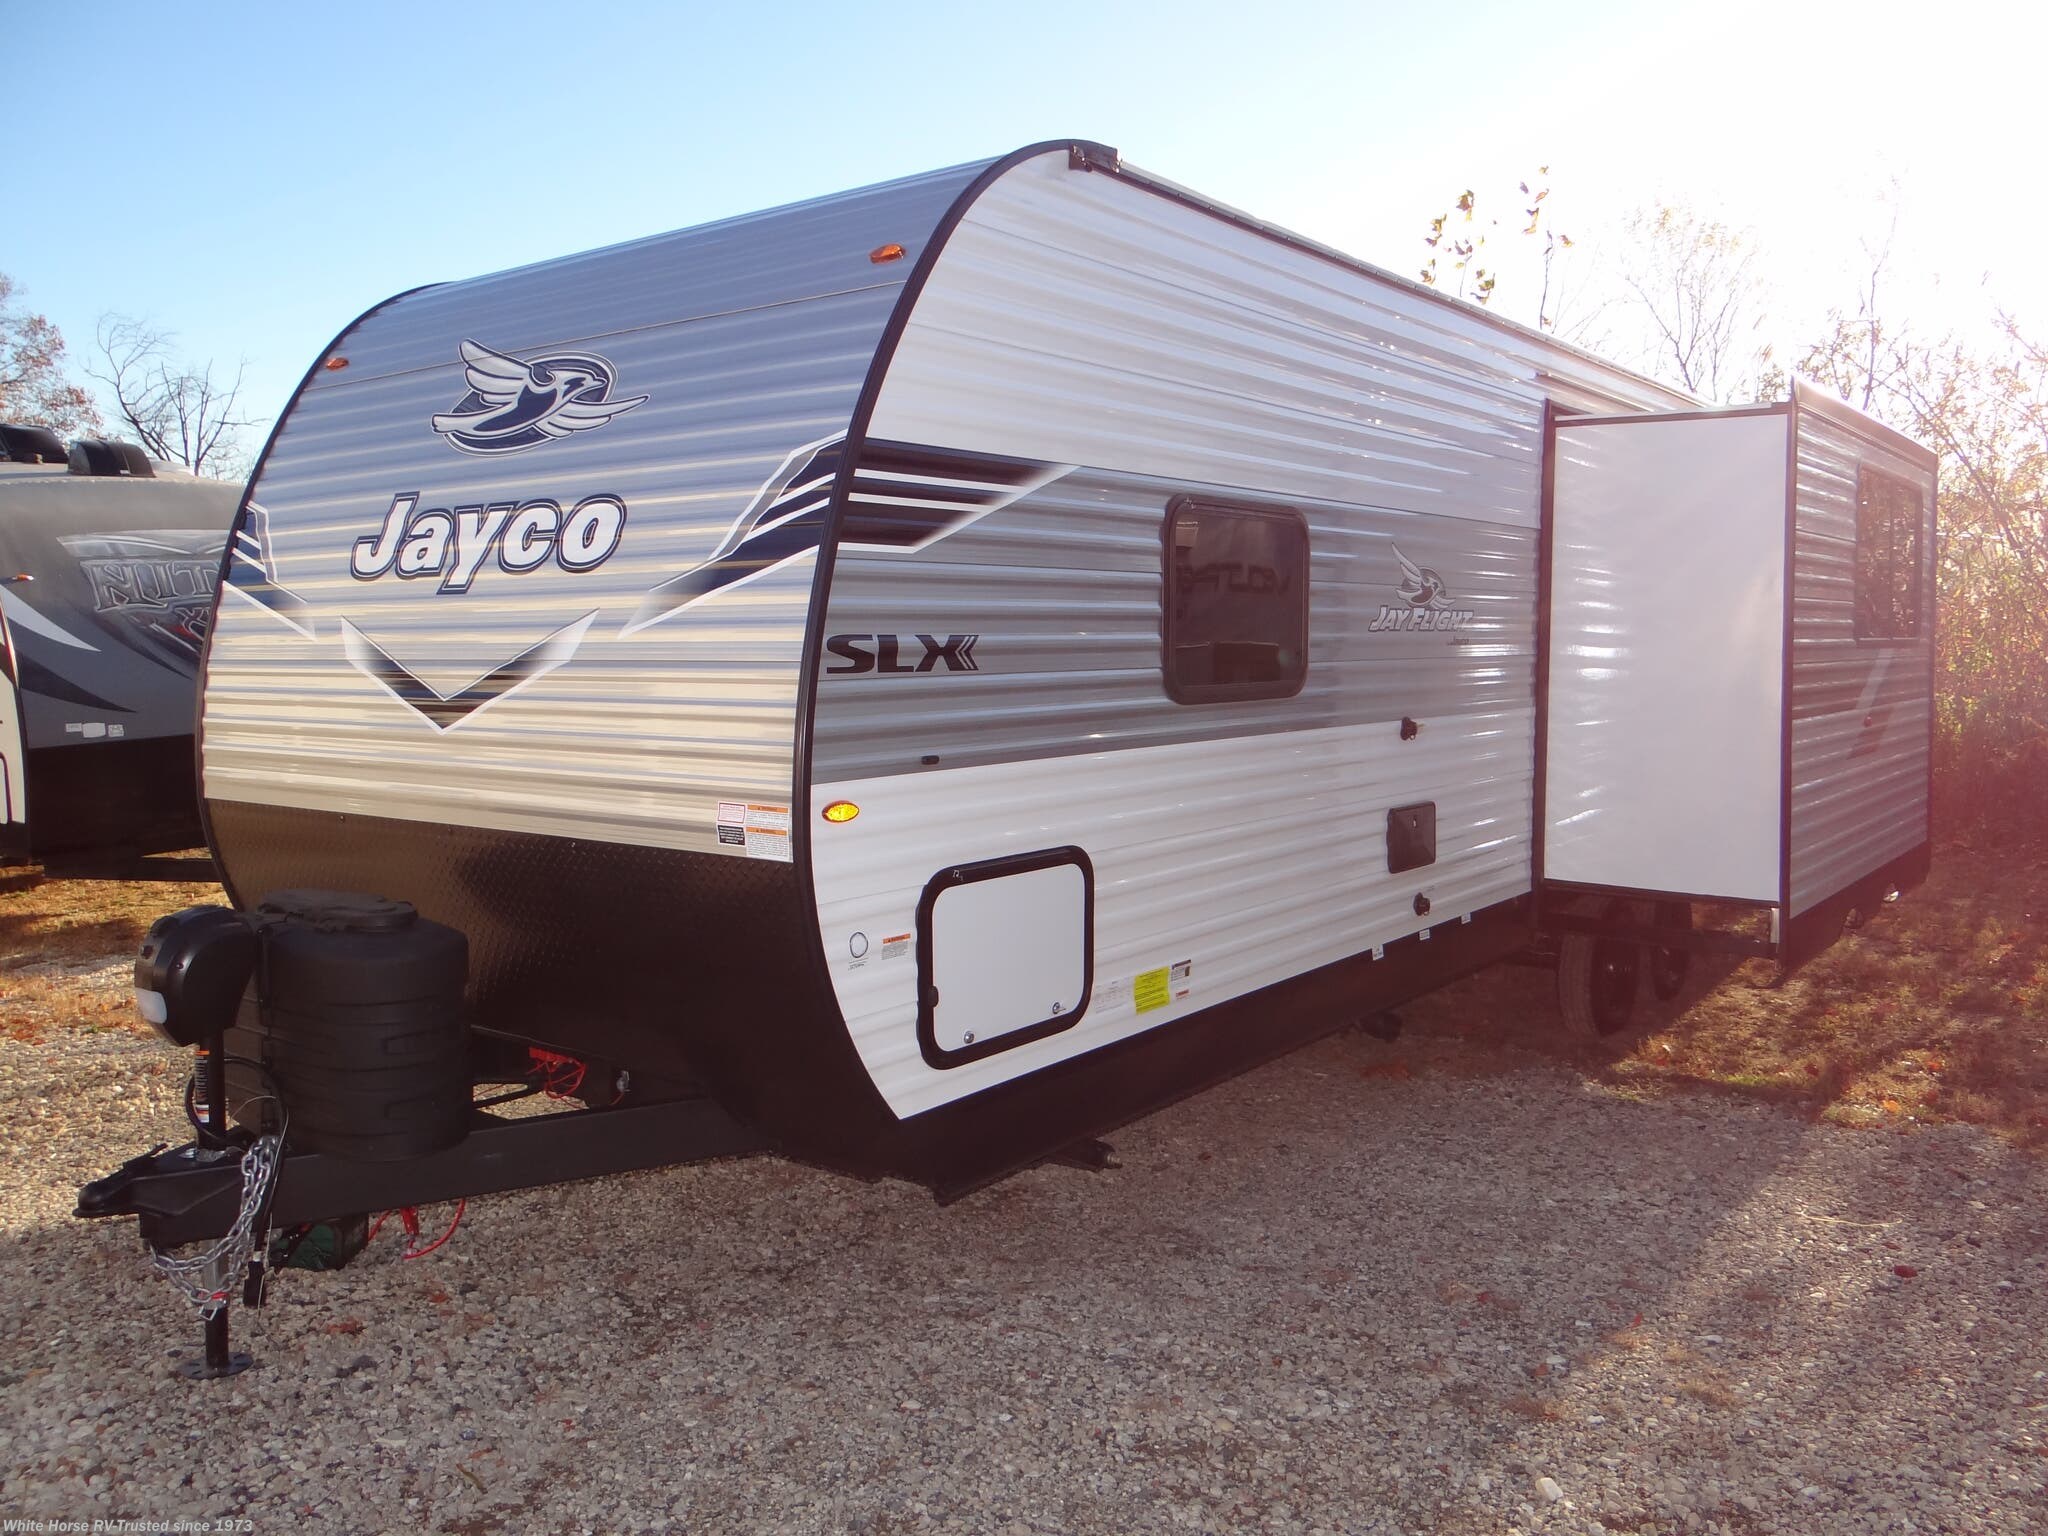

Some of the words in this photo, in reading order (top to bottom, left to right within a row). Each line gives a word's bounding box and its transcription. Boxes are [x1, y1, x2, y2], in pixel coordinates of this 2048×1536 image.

[351, 491, 627, 595] Jayco
[80, 560, 221, 612] NIT
[1368, 605, 1411, 632] JAY
[1405, 607, 1474, 632] FLIGHT
[826, 634, 979, 674] SLX
